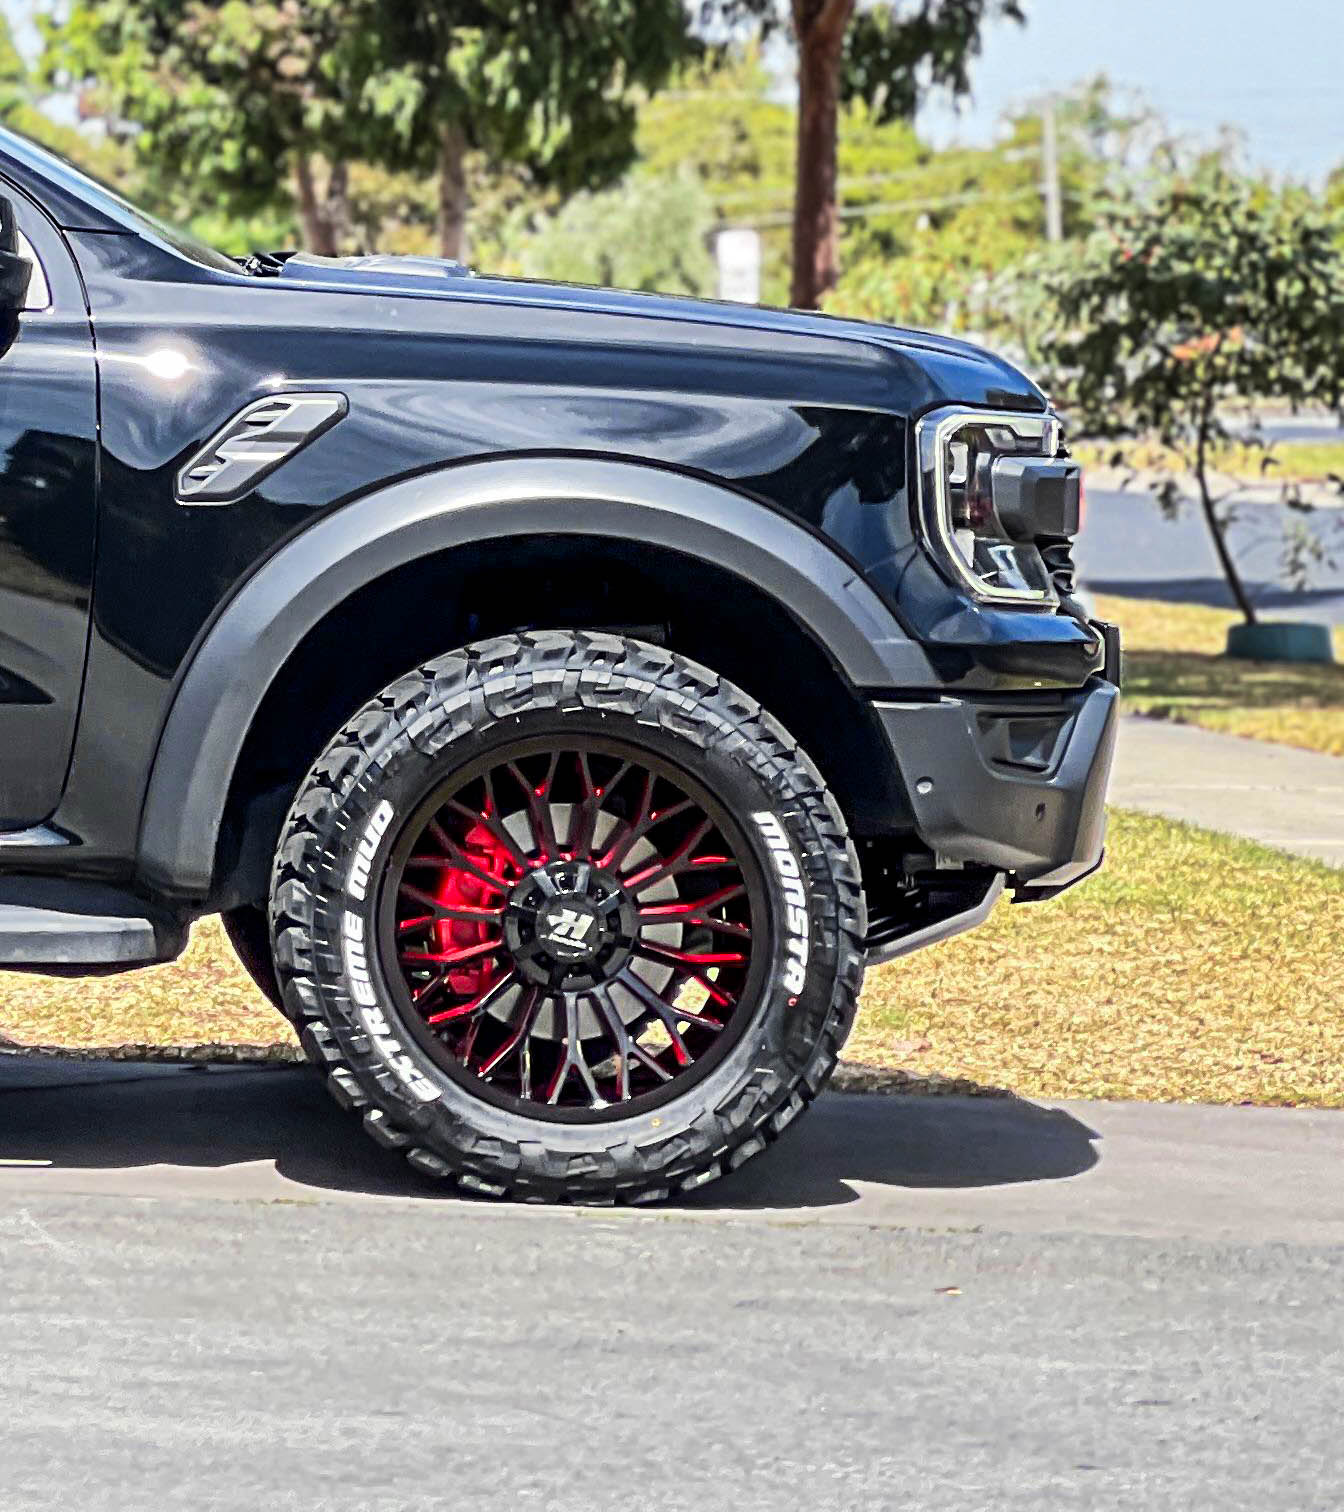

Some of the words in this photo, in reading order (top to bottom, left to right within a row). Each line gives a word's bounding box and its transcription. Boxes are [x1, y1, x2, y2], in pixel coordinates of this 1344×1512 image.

[347, 798, 395, 902] MUD
[751, 810, 810, 995] MONSTA
[343, 909, 444, 1104] EXTREME
